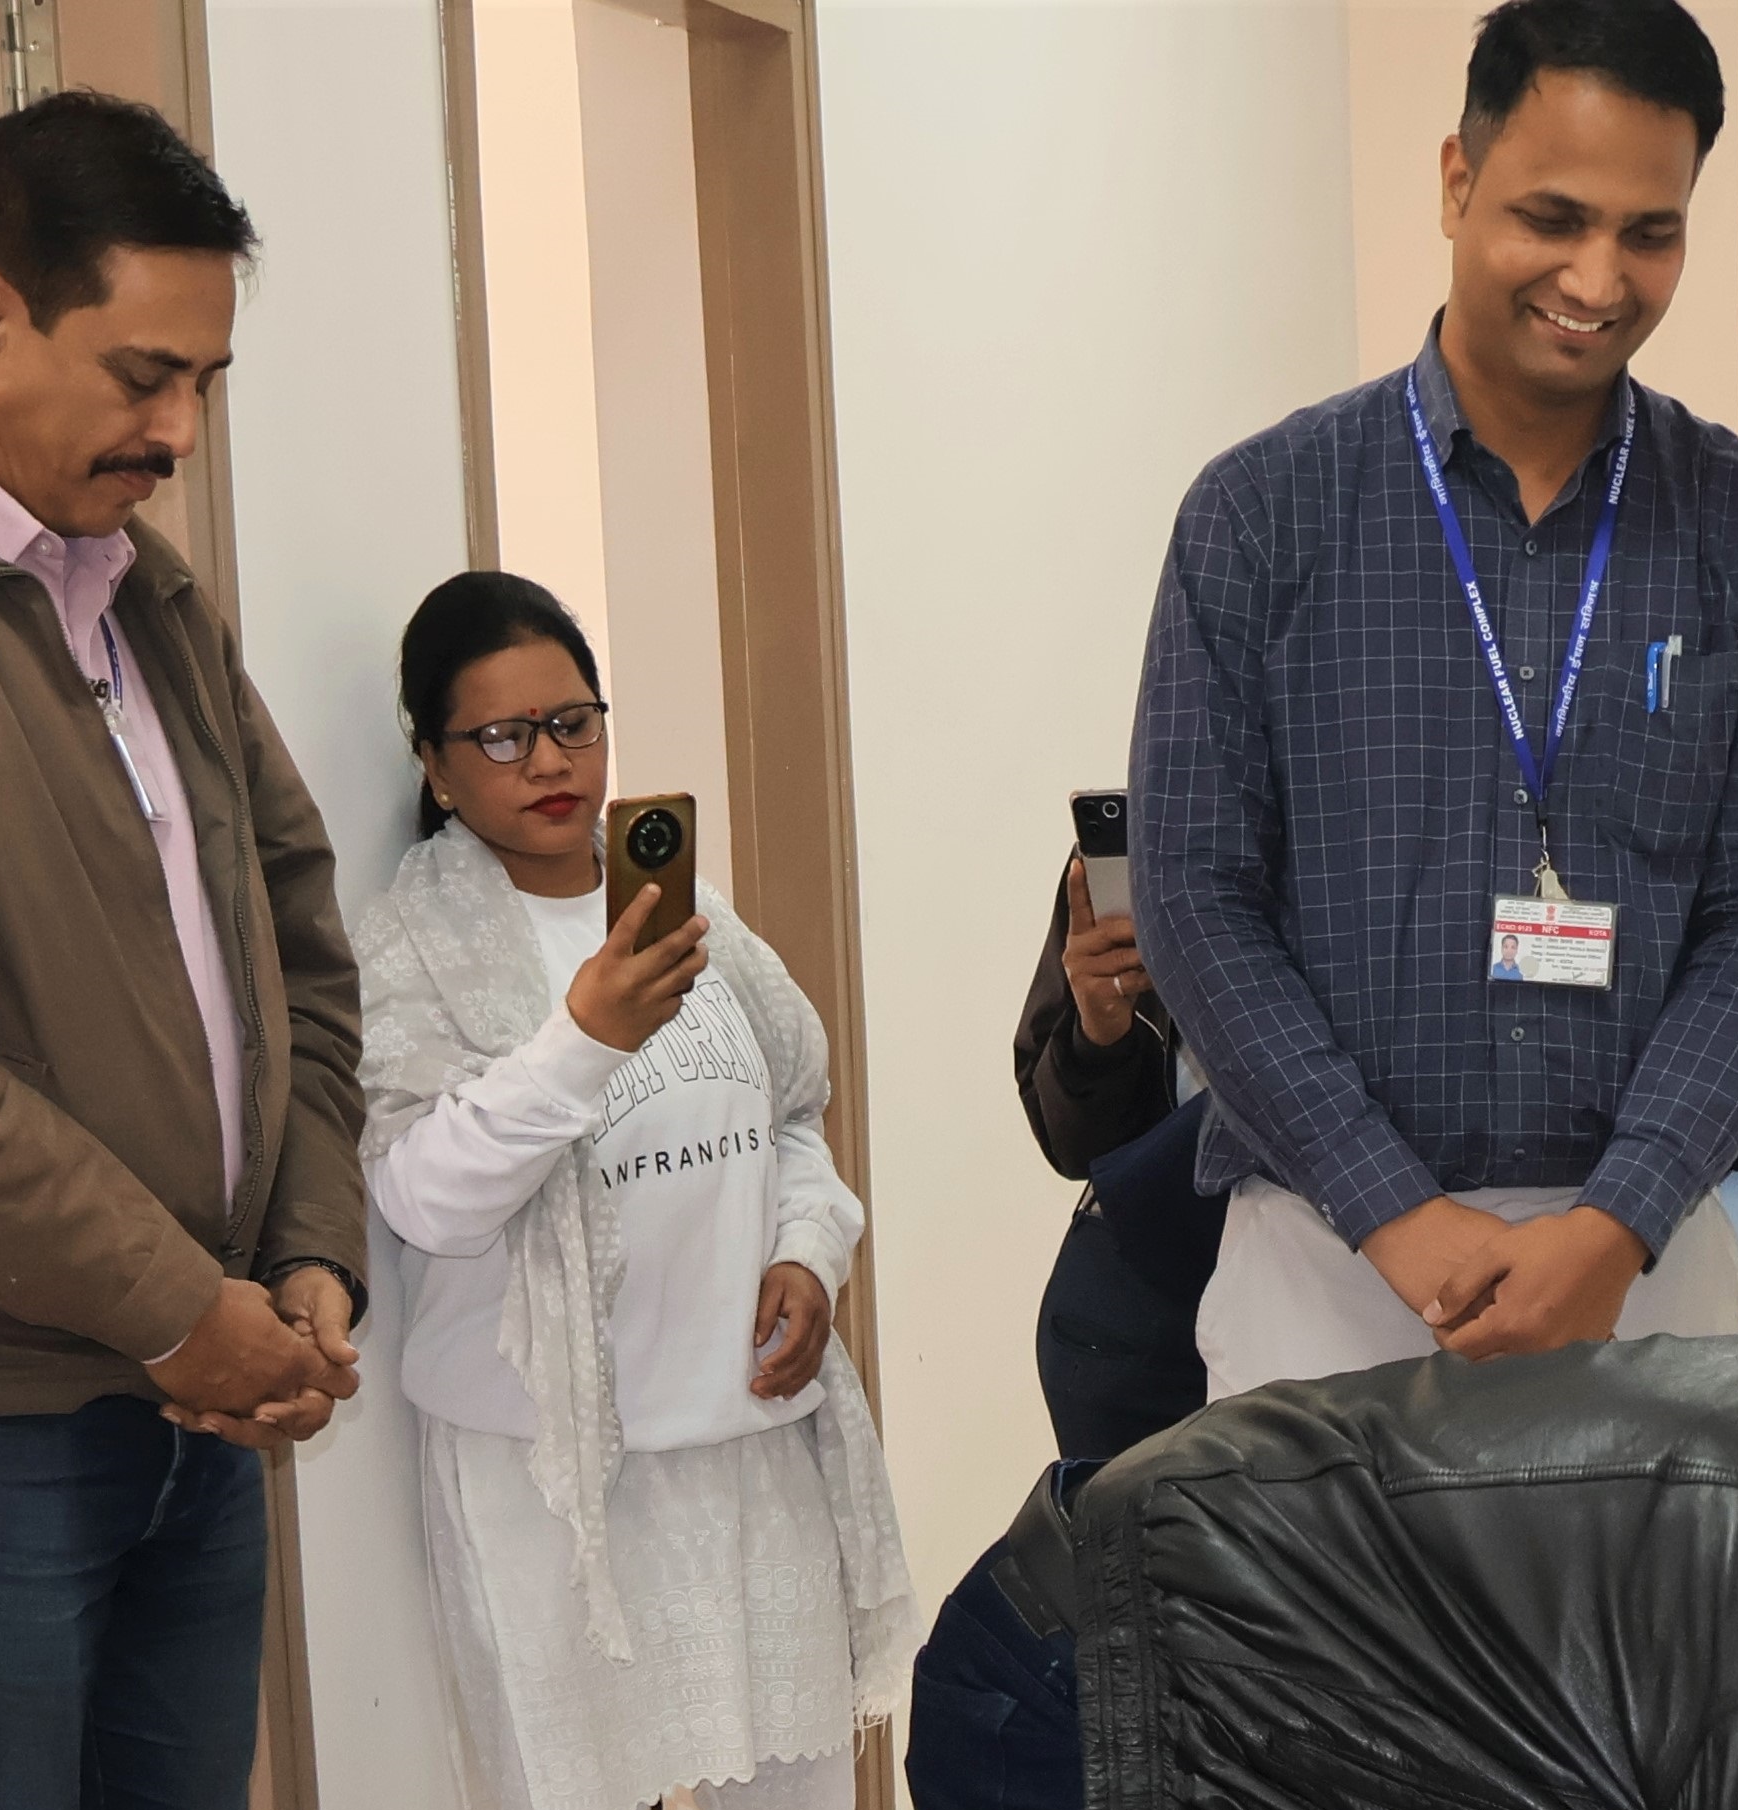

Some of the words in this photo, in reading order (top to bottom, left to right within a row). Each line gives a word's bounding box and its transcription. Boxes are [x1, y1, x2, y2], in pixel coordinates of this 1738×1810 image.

[1608, 446, 1631, 505] NUCLEAR
[1465, 580, 1493, 642] COMPLEX
[1487, 643, 1505, 677] FUEL
[1497, 678, 1525, 740] NUCLEAR
[1541, 925, 1560, 935] NFC
